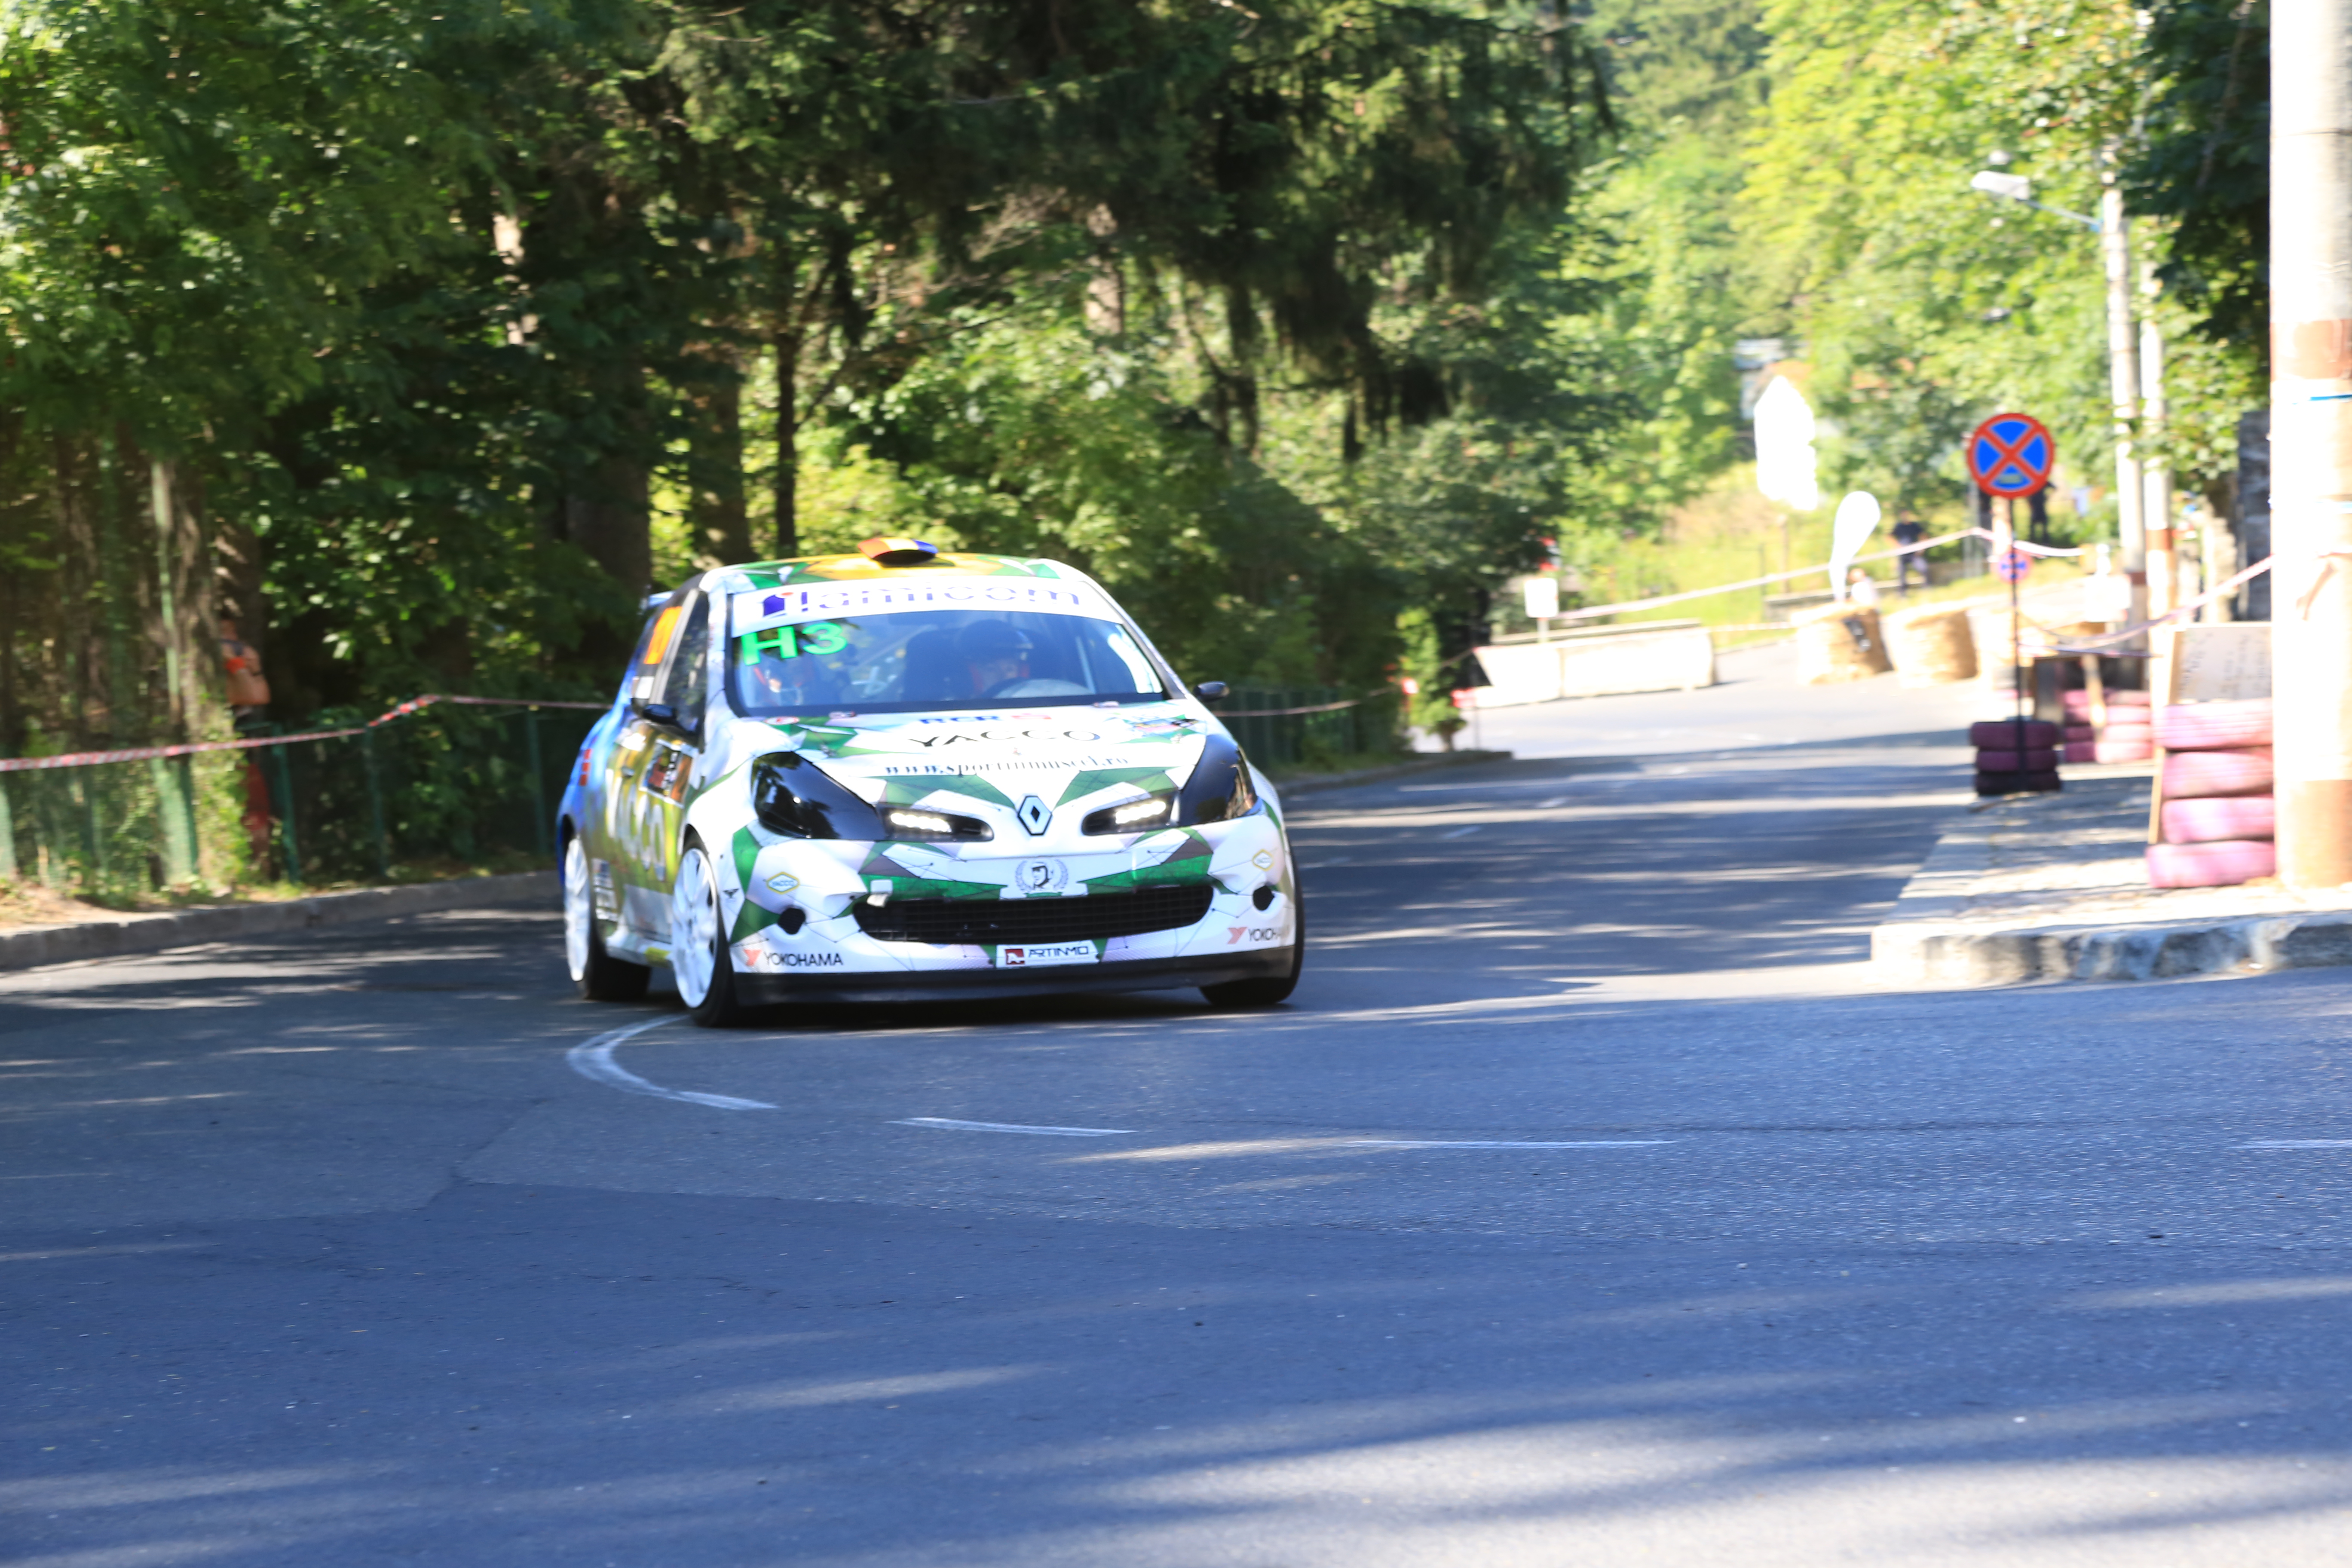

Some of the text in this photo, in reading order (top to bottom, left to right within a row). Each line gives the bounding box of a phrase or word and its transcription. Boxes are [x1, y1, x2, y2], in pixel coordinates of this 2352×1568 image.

[741, 622, 848, 666] H3
[908, 730, 1100, 747] YACCO
[764, 952, 843, 966] YOKOHAMA
